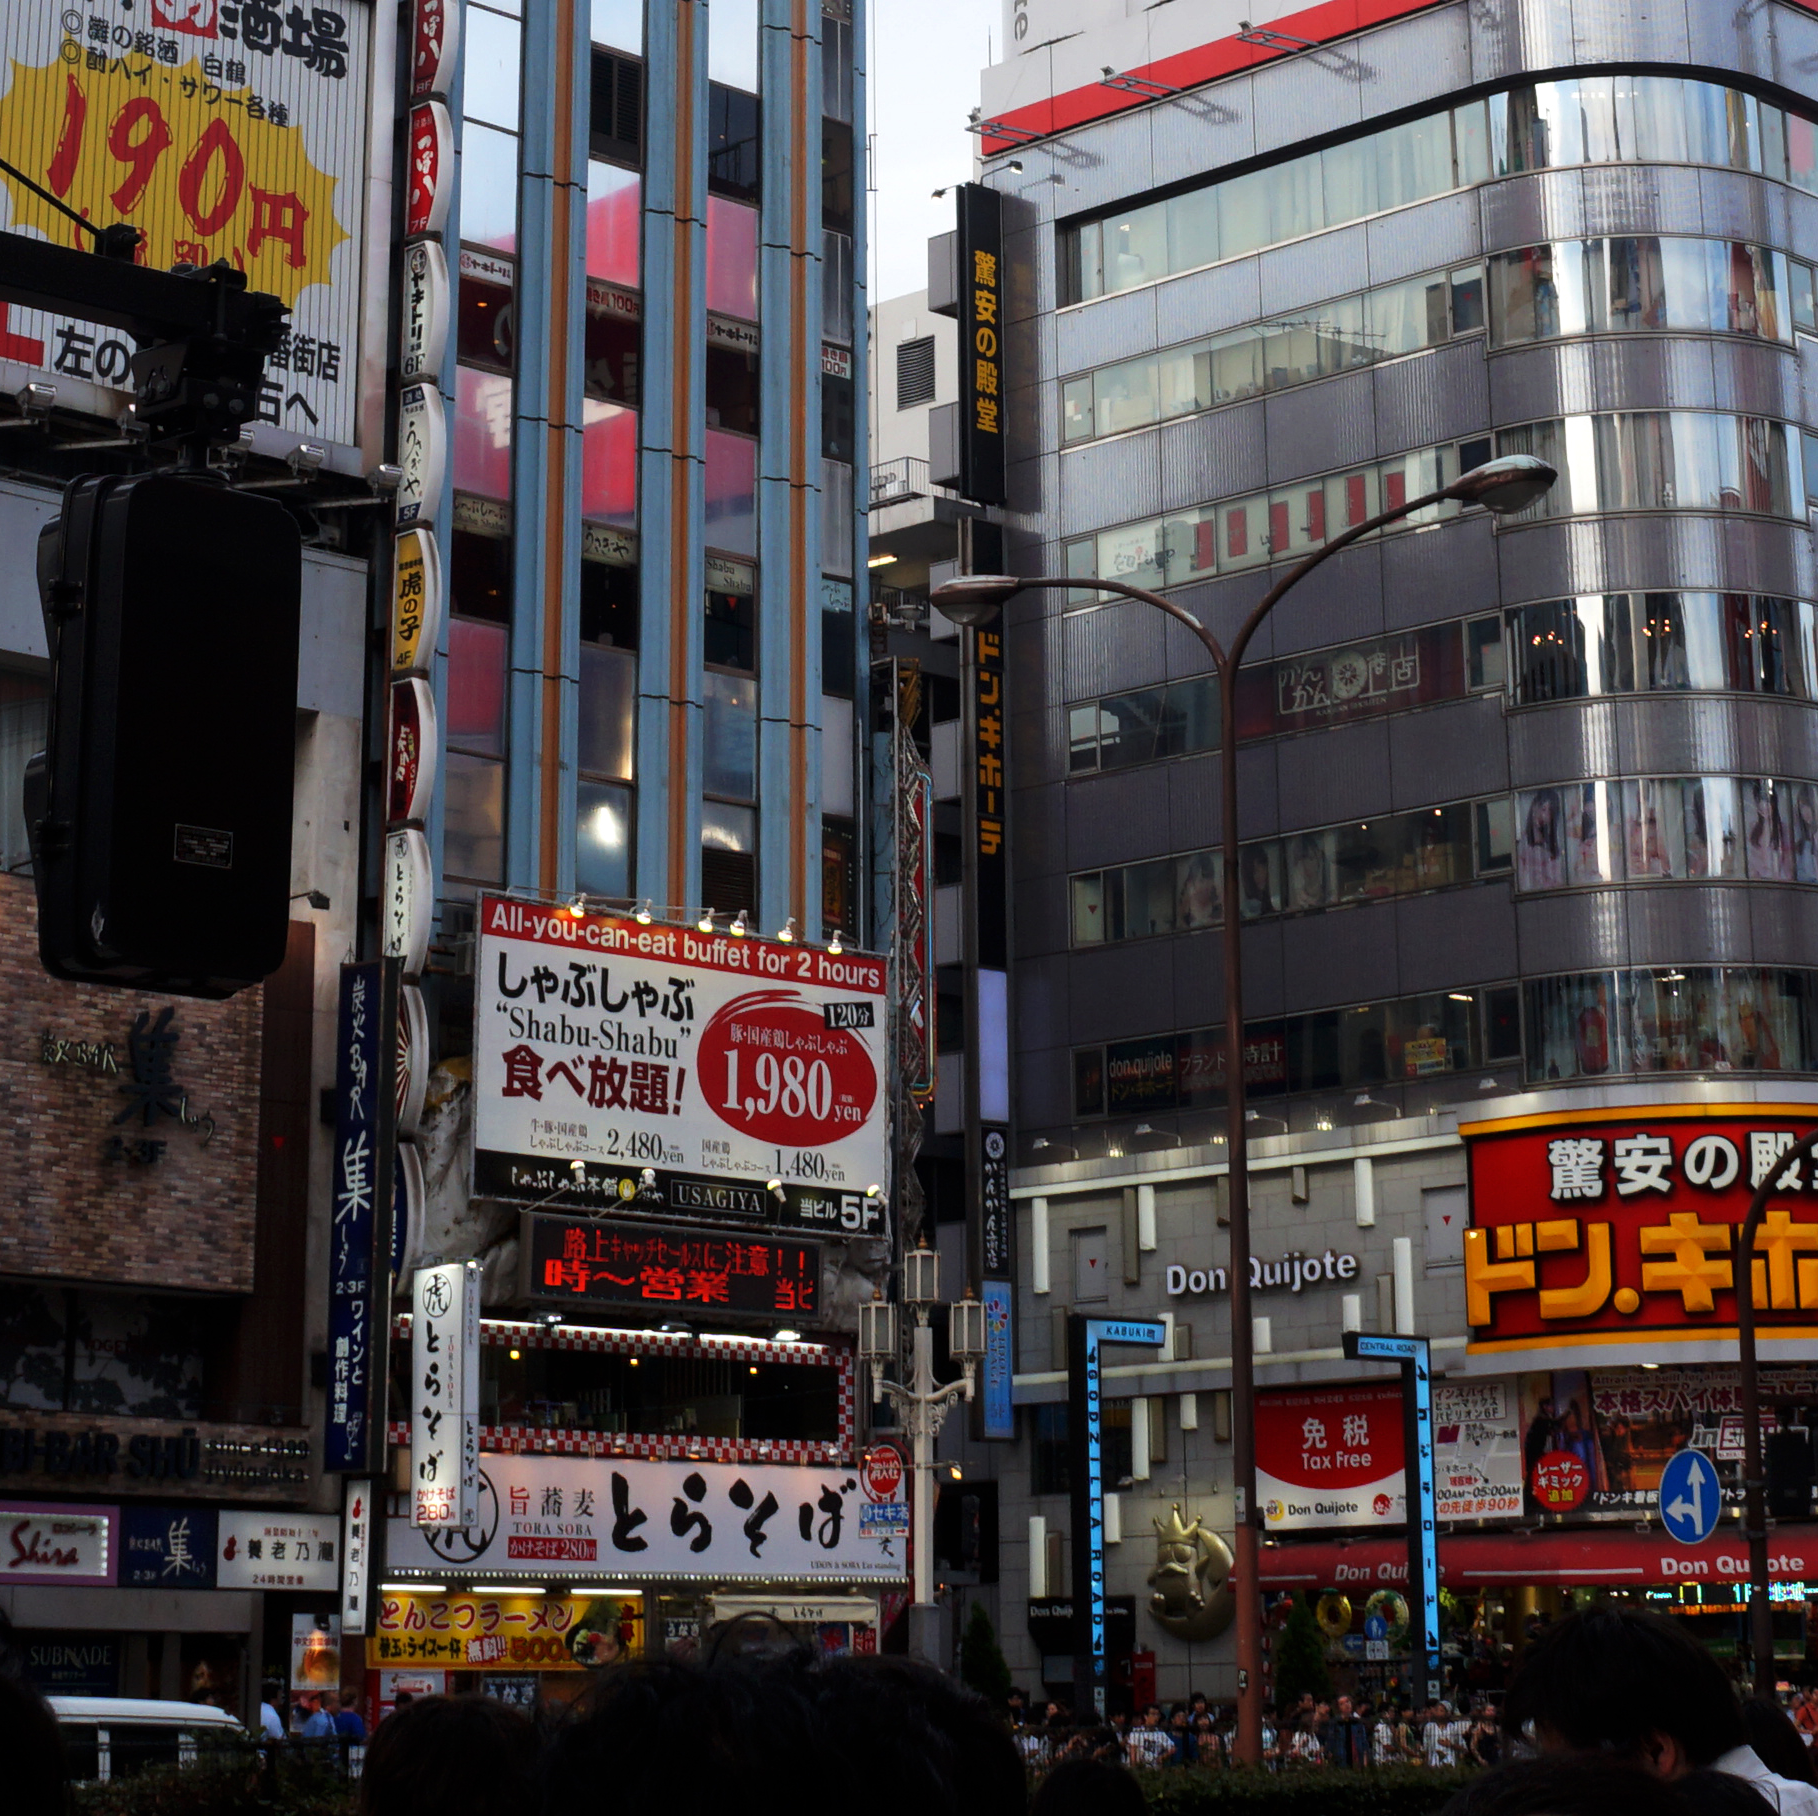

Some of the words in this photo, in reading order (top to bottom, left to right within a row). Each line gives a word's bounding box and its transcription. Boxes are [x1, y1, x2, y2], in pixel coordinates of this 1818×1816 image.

[420, 2, 439, 67] つぼ八
[47, 73, 310, 270] 190円
[410, 218, 427, 232] 7F
[974, 249, 999, 434] 驚安の殿堂
[403, 354, 424, 375] 6F
[397, 570, 422, 642] 虎の子
[396, 650, 412, 666] 4F
[490, 902, 677, 959] All-you-can-eat
[683, 929, 753, 968] buffet
[756, 944, 789, 973] for
[797, 957, 812, 979] 2
[817, 959, 881, 988] hours
[498, 951, 696, 1022] しゃぶしゃぶ
[826, 1003, 872, 1029] 120分
[722, 1046, 832, 1122] 1,980
[677, 1184, 763, 1214] USAGIYA
[839, 1196, 880, 1233] 5F
[1165, 1263, 1227, 1297] Don
[349, 1299, 367, 1386] ワインと
[332, 1334, 351, 1427] 創作料理
[419, 1320, 444, 1482] とらそば
[1087, 1369, 1102, 1529] GODZILLA
[1301, 1415, 1370, 1451] 免税
[1301, 1452, 1332, 1470] Tax
[1335, 1449, 1372, 1468] Free
[1537, 1461, 1583, 1476] レーザー
[416, 1486, 457, 1501] かけそば
[1537, 1474, 1583, 1489] ギミック
[1547, 1488, 1573, 1502] 追加
[416, 1503, 457, 1522] 280円
[611, 1470, 857, 1558] とらそば
[1287, 1502, 1310, 1516] Don
[1311, 1501, 1359, 1516] Quijote
[8, 1520, 79, 1568] Shira
[512, 1522, 551, 1536] TORA
[557, 1522, 593, 1537] SOBA
[1334, 1563, 1371, 1581] Don
[1660, 1556, 1709, 1576] Don
[1090, 1548, 1104, 1628] ROAD
[379, 1599, 574, 1633] とんこつラーメン
[29, 1644, 113, 1668] SUBNADE
